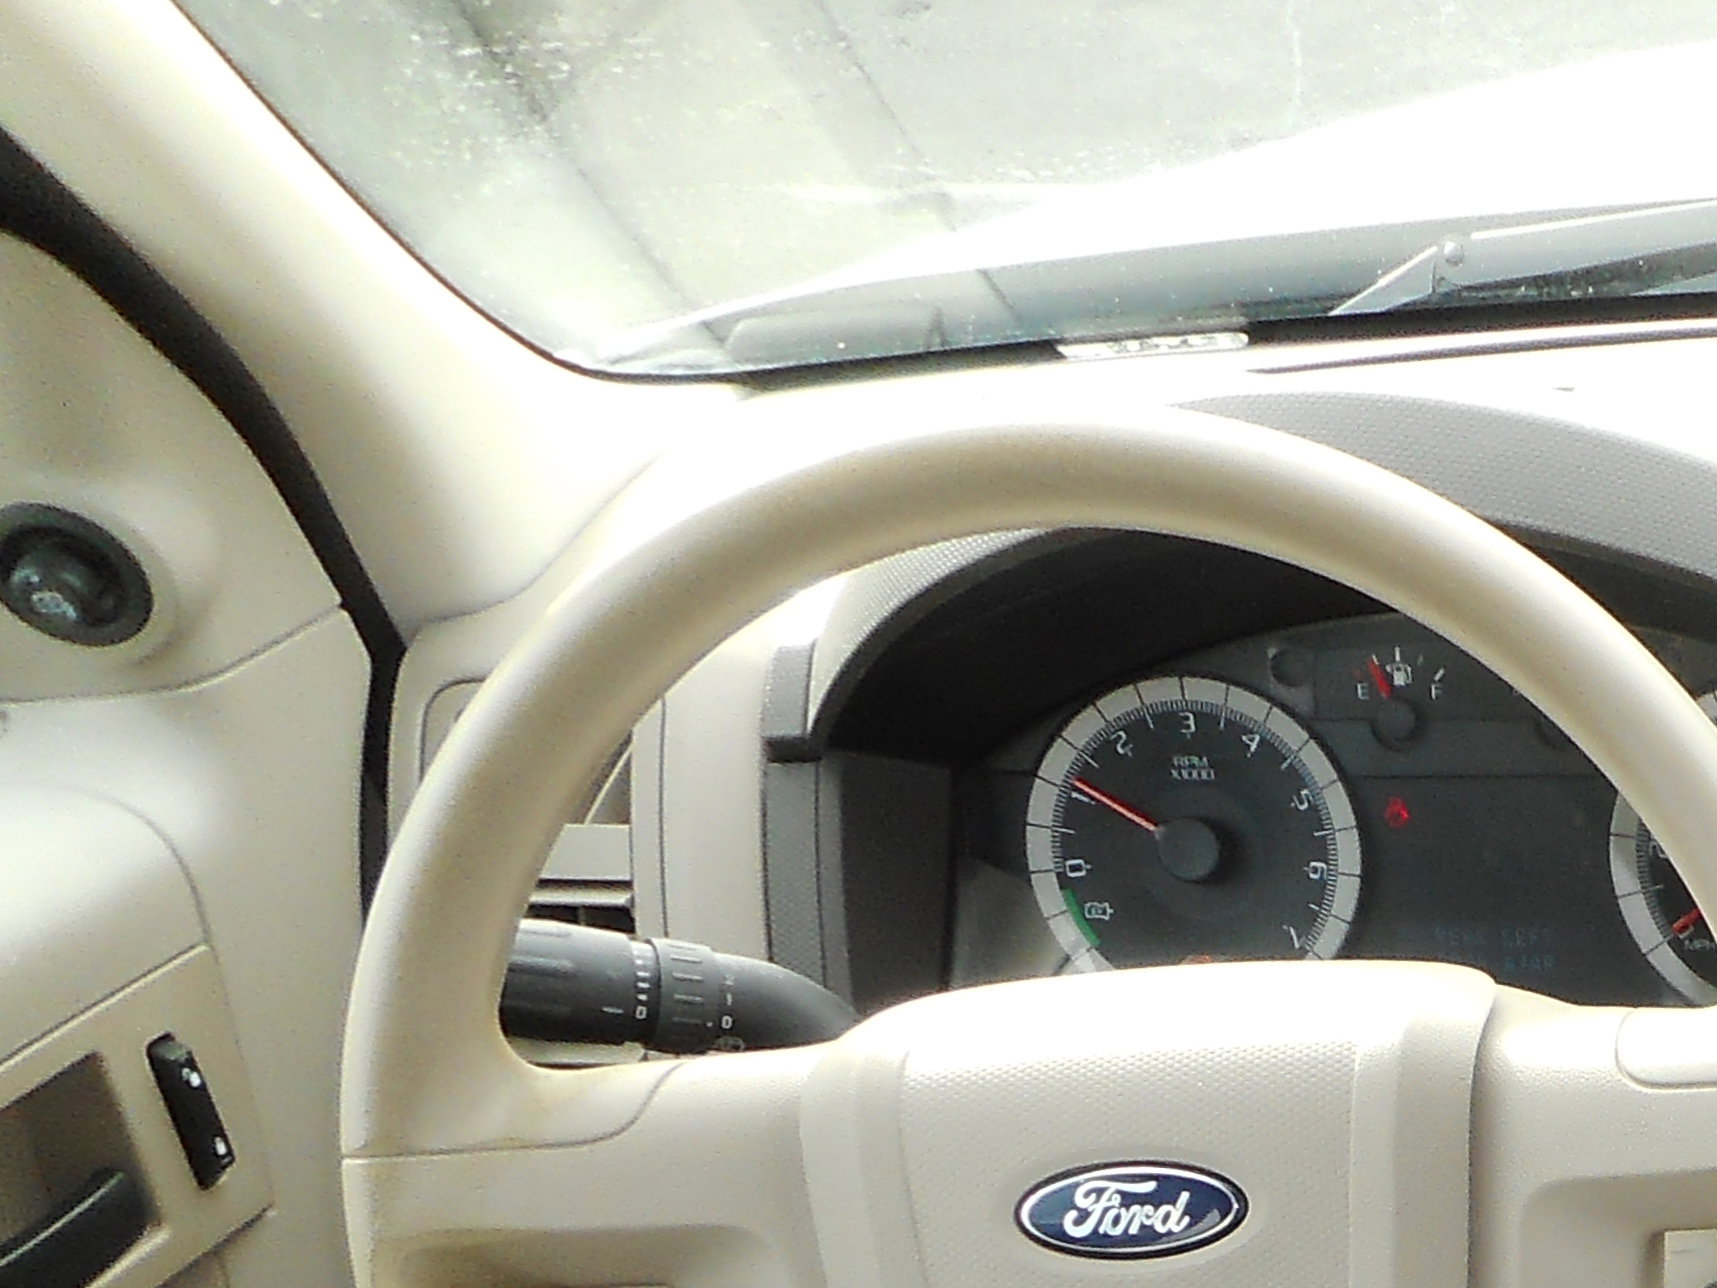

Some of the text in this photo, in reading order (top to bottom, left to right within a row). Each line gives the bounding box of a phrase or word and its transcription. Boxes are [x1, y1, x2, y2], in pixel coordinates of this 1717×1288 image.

[1357, 683, 1368, 699] E
[1431, 684, 1442, 699] F
[1180, 713, 1196, 733] 3
[1112, 731, 1129, 754] 2
[1242, 733, 1260, 753] 4
[1071, 789, 1091, 803] 1
[1295, 788, 1314, 811] 5
[1065, 859, 1086, 877] 0
[1309, 861, 1328, 879] 6
[635, 1005, 647, 1019] 0
[721, 1015, 733, 1029] 0
[1063, 1180, 1191, 1238] Ford
